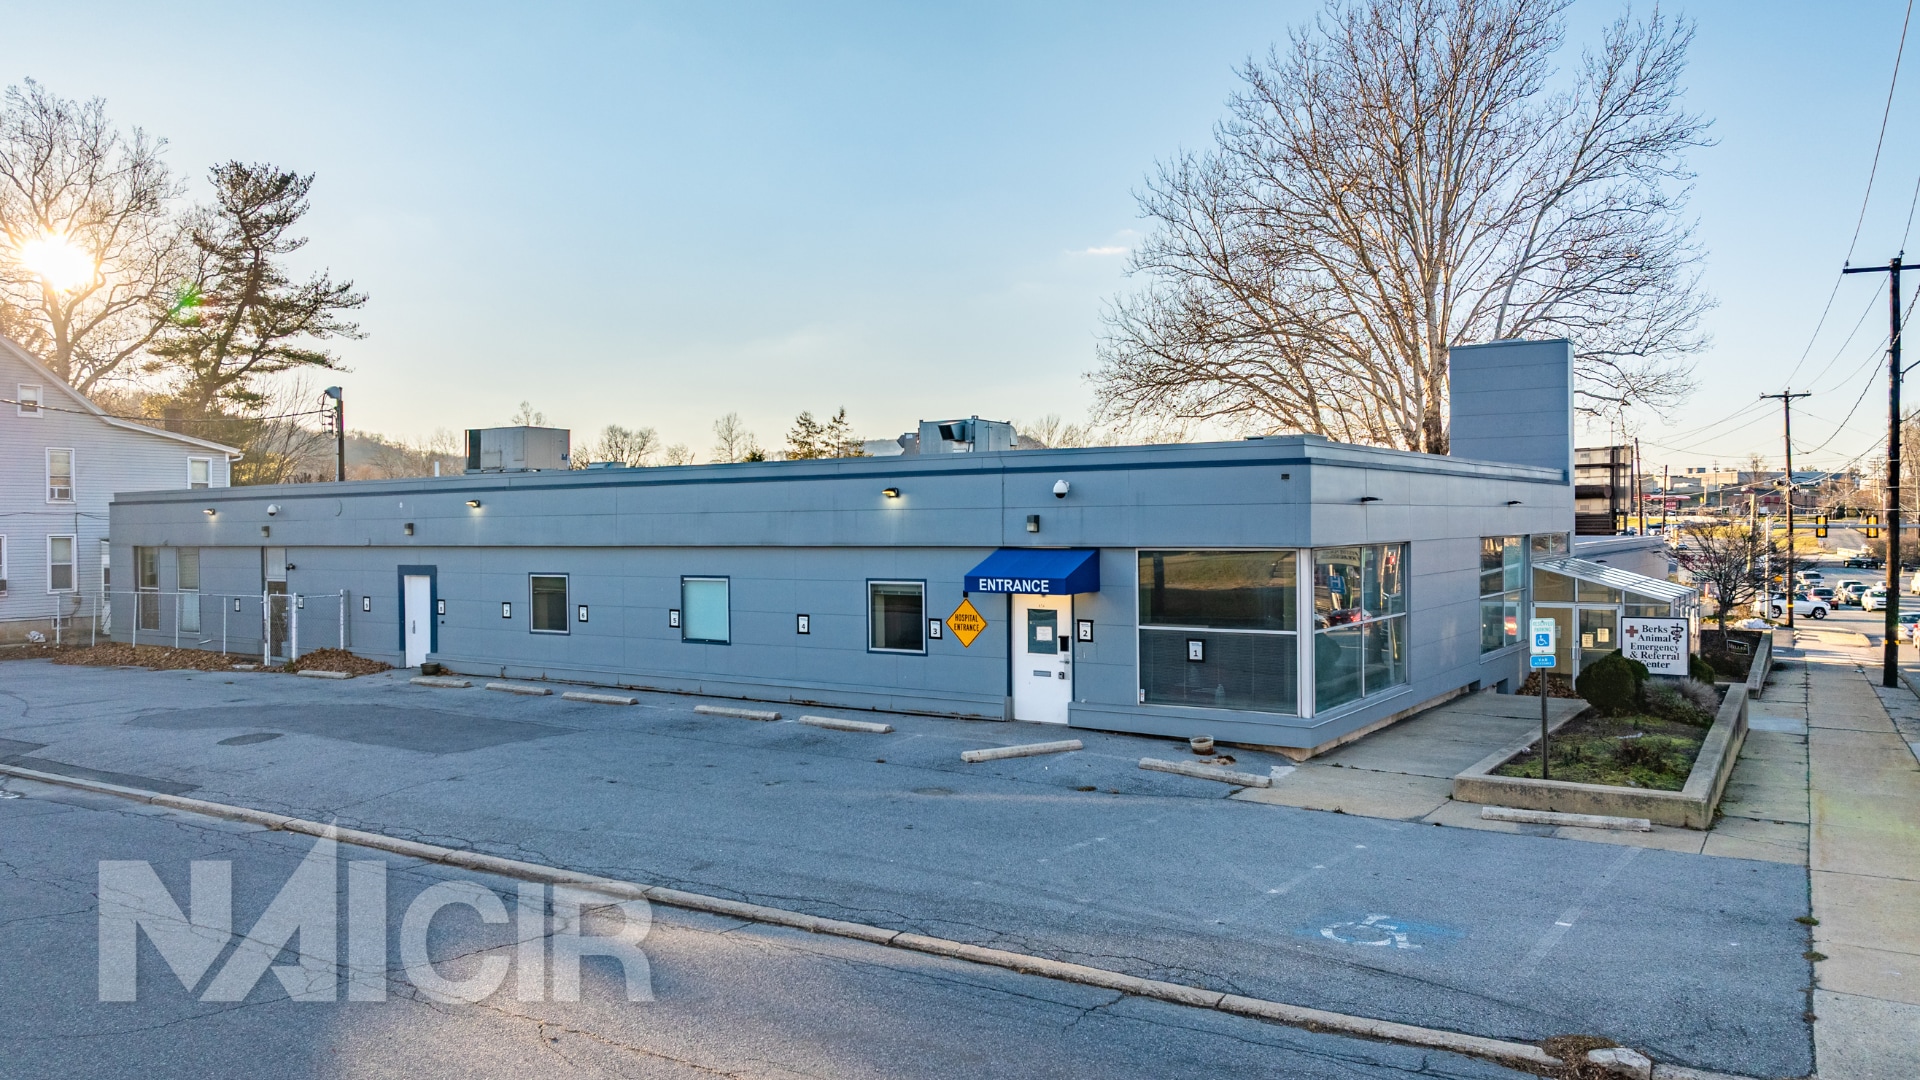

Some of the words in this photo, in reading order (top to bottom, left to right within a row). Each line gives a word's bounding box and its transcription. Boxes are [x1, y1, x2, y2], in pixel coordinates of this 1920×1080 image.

[979, 578, 1050, 593] ENTRANCE
[955, 614, 978, 623] HOSPITAL
[954, 623, 979, 632] ENTRANCE
[1642, 625, 1668, 633] Berks
[1638, 634, 1671, 642] Animal
[1630, 642, 1679, 654] Emergency
[1630, 651, 1638, 659] &
[1641, 651, 1680, 660] Referral
